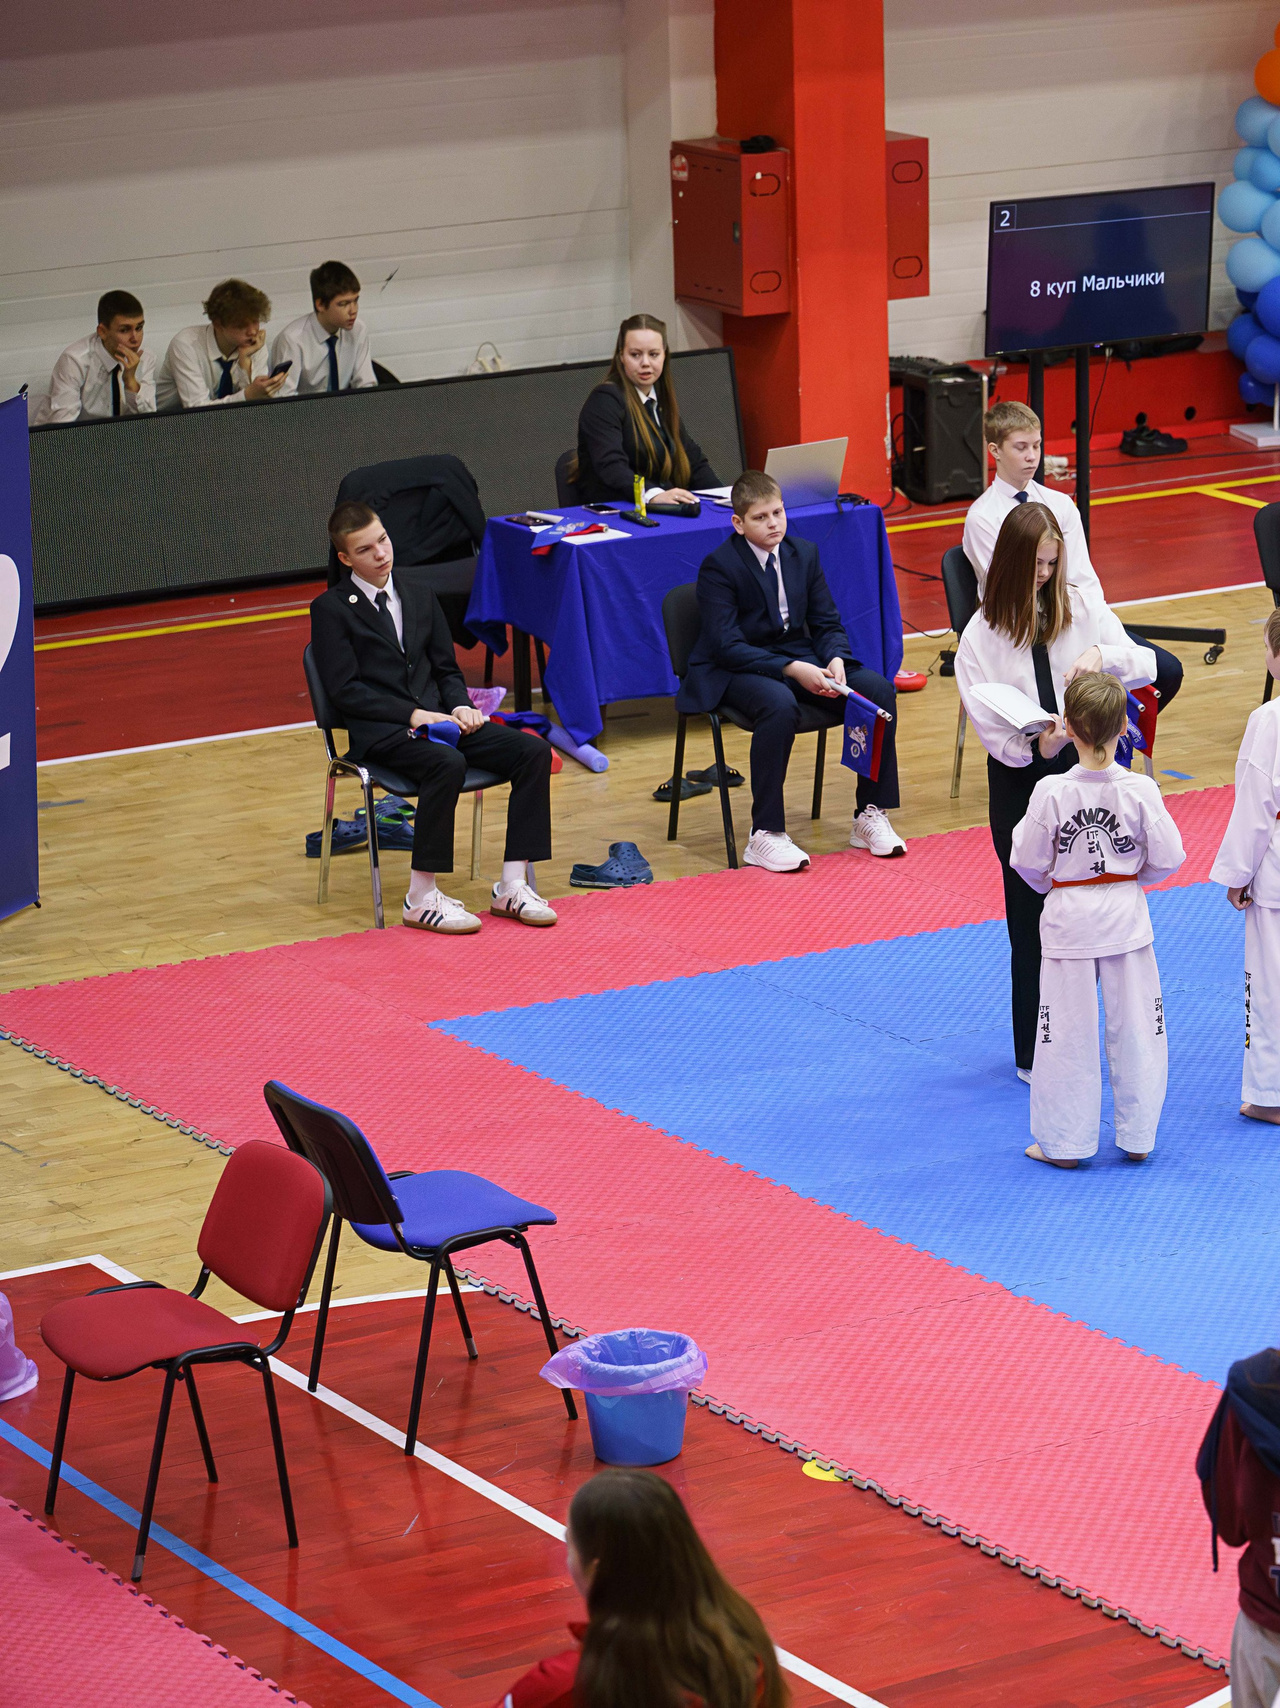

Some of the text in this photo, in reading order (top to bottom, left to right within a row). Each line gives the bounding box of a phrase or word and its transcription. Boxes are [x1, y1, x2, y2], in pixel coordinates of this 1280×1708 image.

[1000, 210, 1011, 227] 2
[1030, 271, 1165, 298] 8 куп Мальчики
[1086, 830, 1099, 840] ITF
